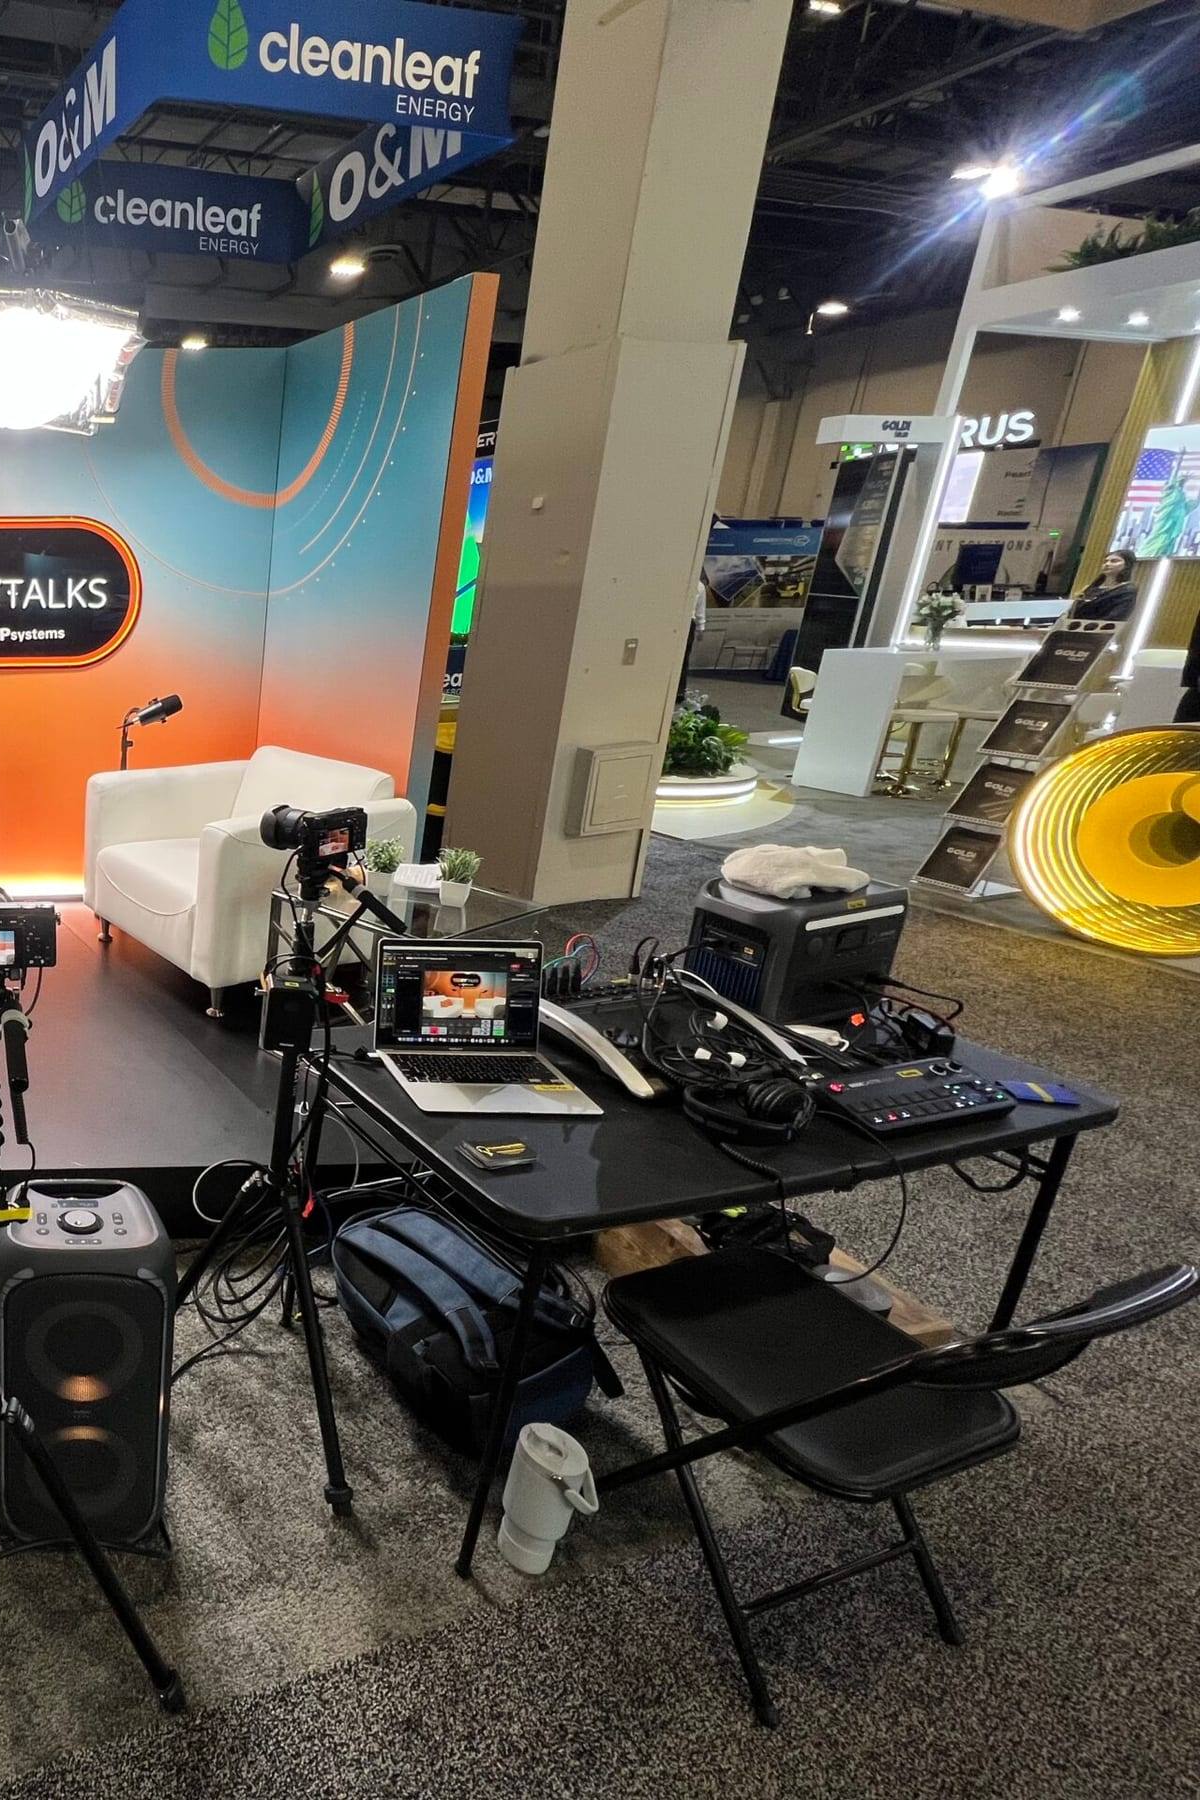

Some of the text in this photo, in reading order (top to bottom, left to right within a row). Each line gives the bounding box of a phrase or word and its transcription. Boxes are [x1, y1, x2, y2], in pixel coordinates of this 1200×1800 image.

[258, 22, 481, 99] cleanleaf
[34, 36, 117, 198] O&M
[395, 94, 476, 124] ENERGY
[328, 122, 462, 223] O&M
[93, 188, 262, 239] cleanleaf
[199, 235, 260, 257] ENERGY
[881, 420, 912, 431] GOLDI
[1054, 648, 1090, 658] GOLDI
